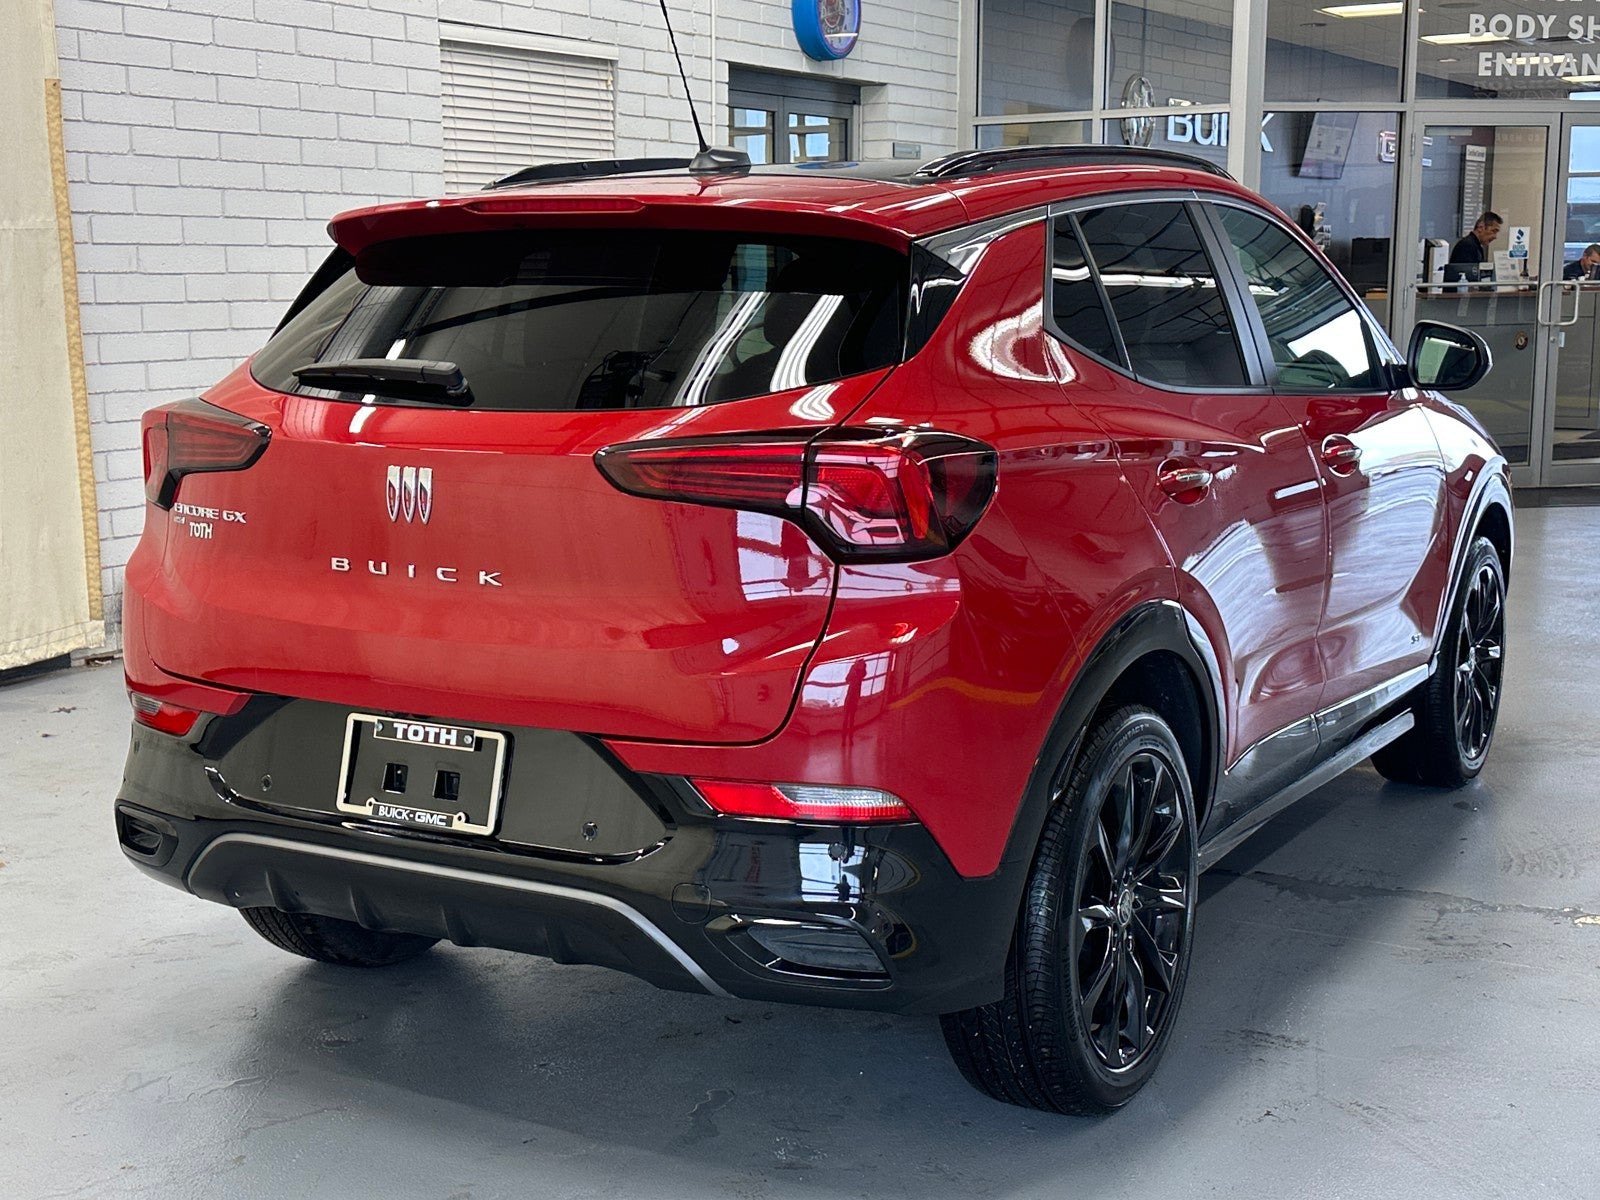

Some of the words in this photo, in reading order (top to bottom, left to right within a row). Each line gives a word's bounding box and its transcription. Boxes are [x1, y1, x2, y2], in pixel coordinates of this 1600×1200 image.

[1469, 13, 1558, 39] BODY
[1478, 51, 1600, 77] ENTRAN
[1167, 97, 1275, 152] BUIK
[174, 502, 219, 519] ENCORE
[222, 510, 247, 524] GX
[189, 521, 213, 539] TOTH
[330, 556, 503, 587] BUICK
[392, 722, 457, 746] TOTH
